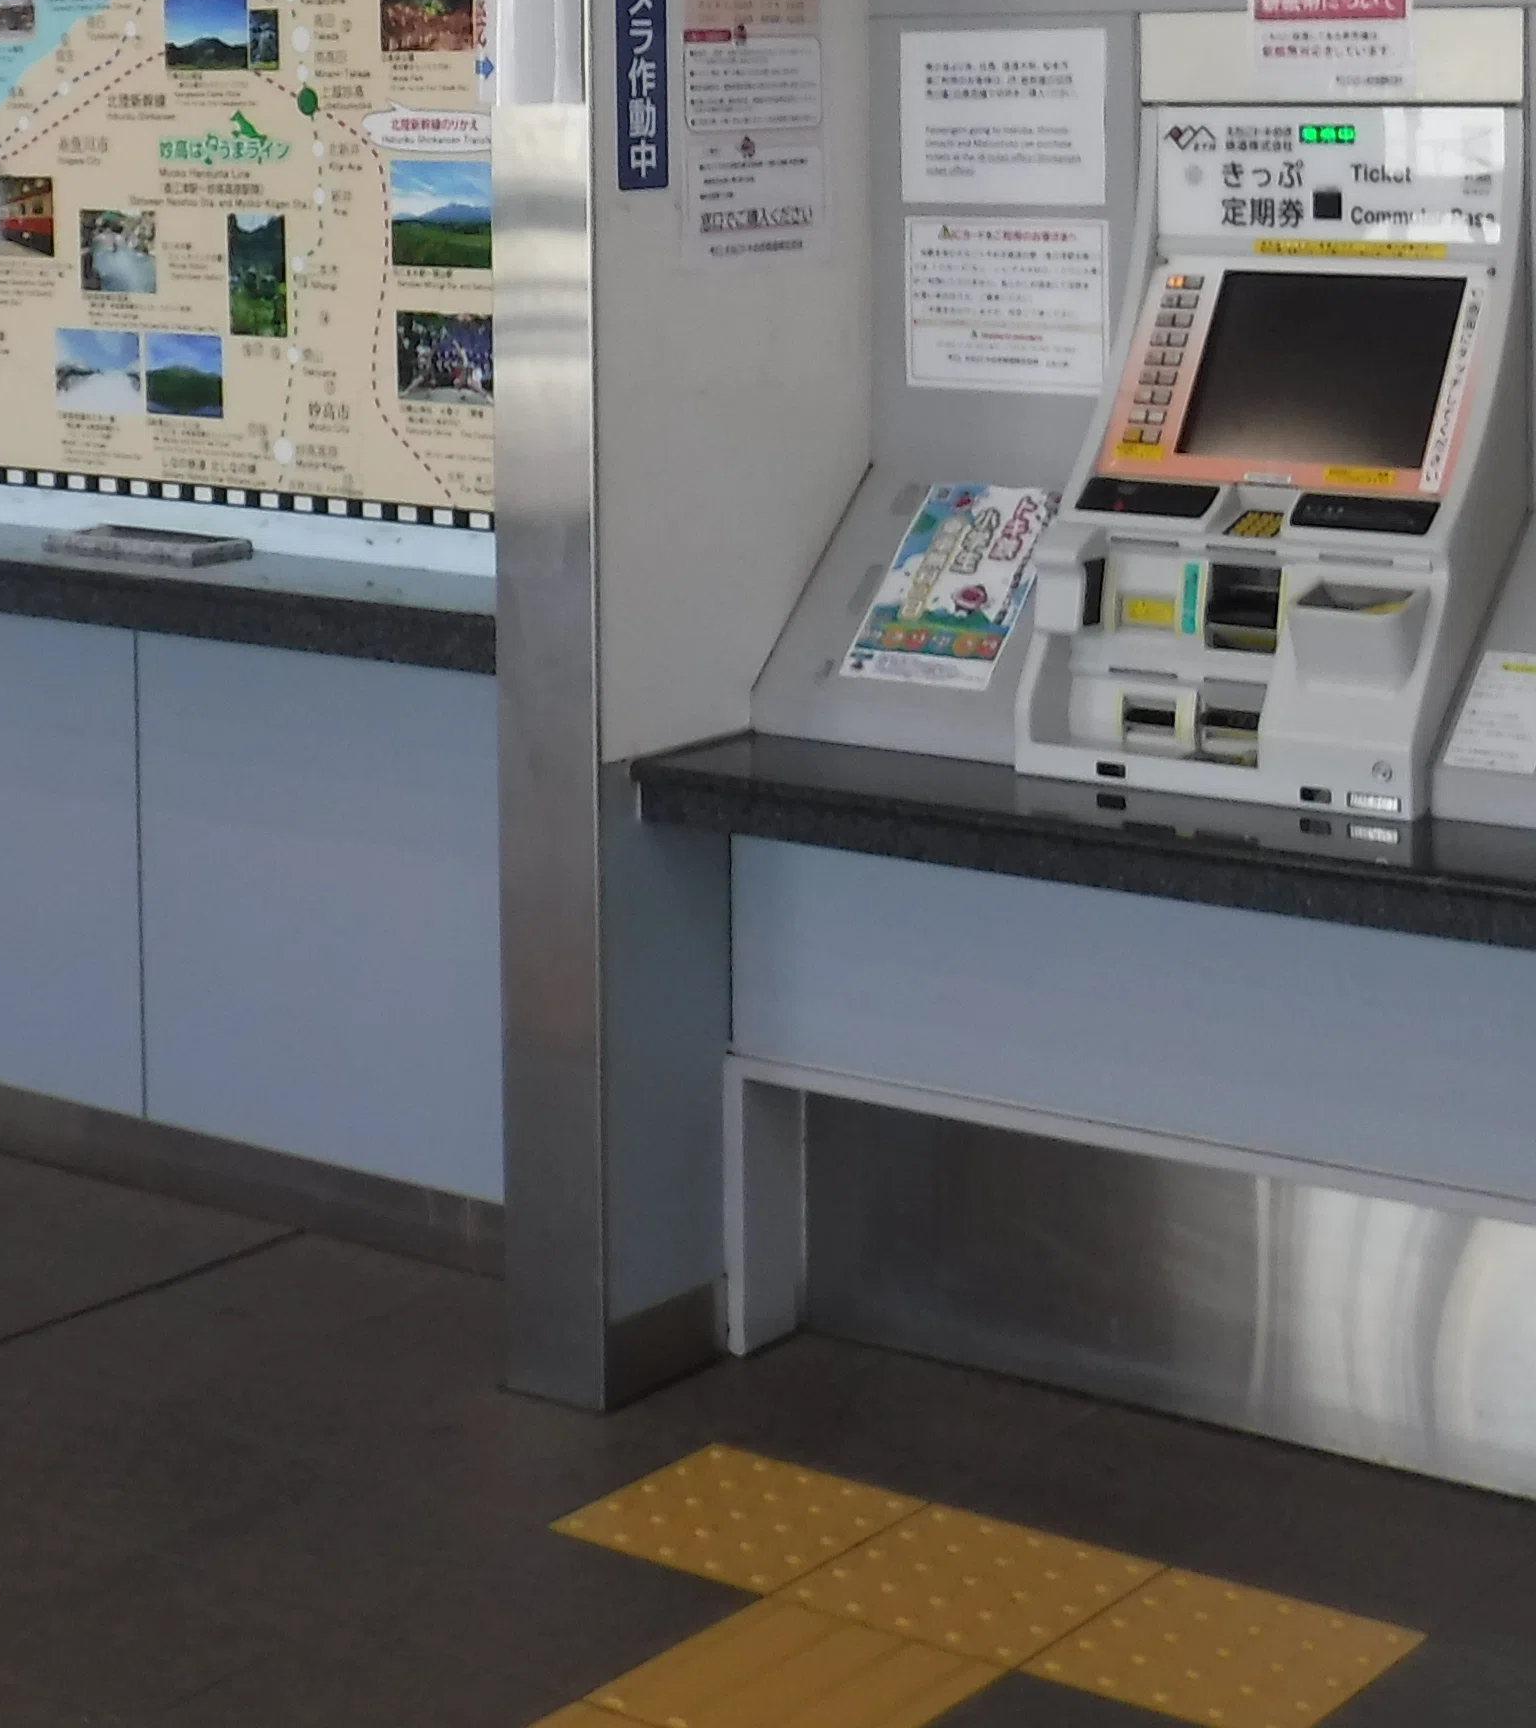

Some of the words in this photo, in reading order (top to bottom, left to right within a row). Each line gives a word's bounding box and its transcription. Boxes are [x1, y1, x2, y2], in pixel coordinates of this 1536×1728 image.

[1222, 159, 1305, 188] きっぷ
[1351, 163, 1412, 183] Ticket
[1221, 197, 1305, 227] 定期券
